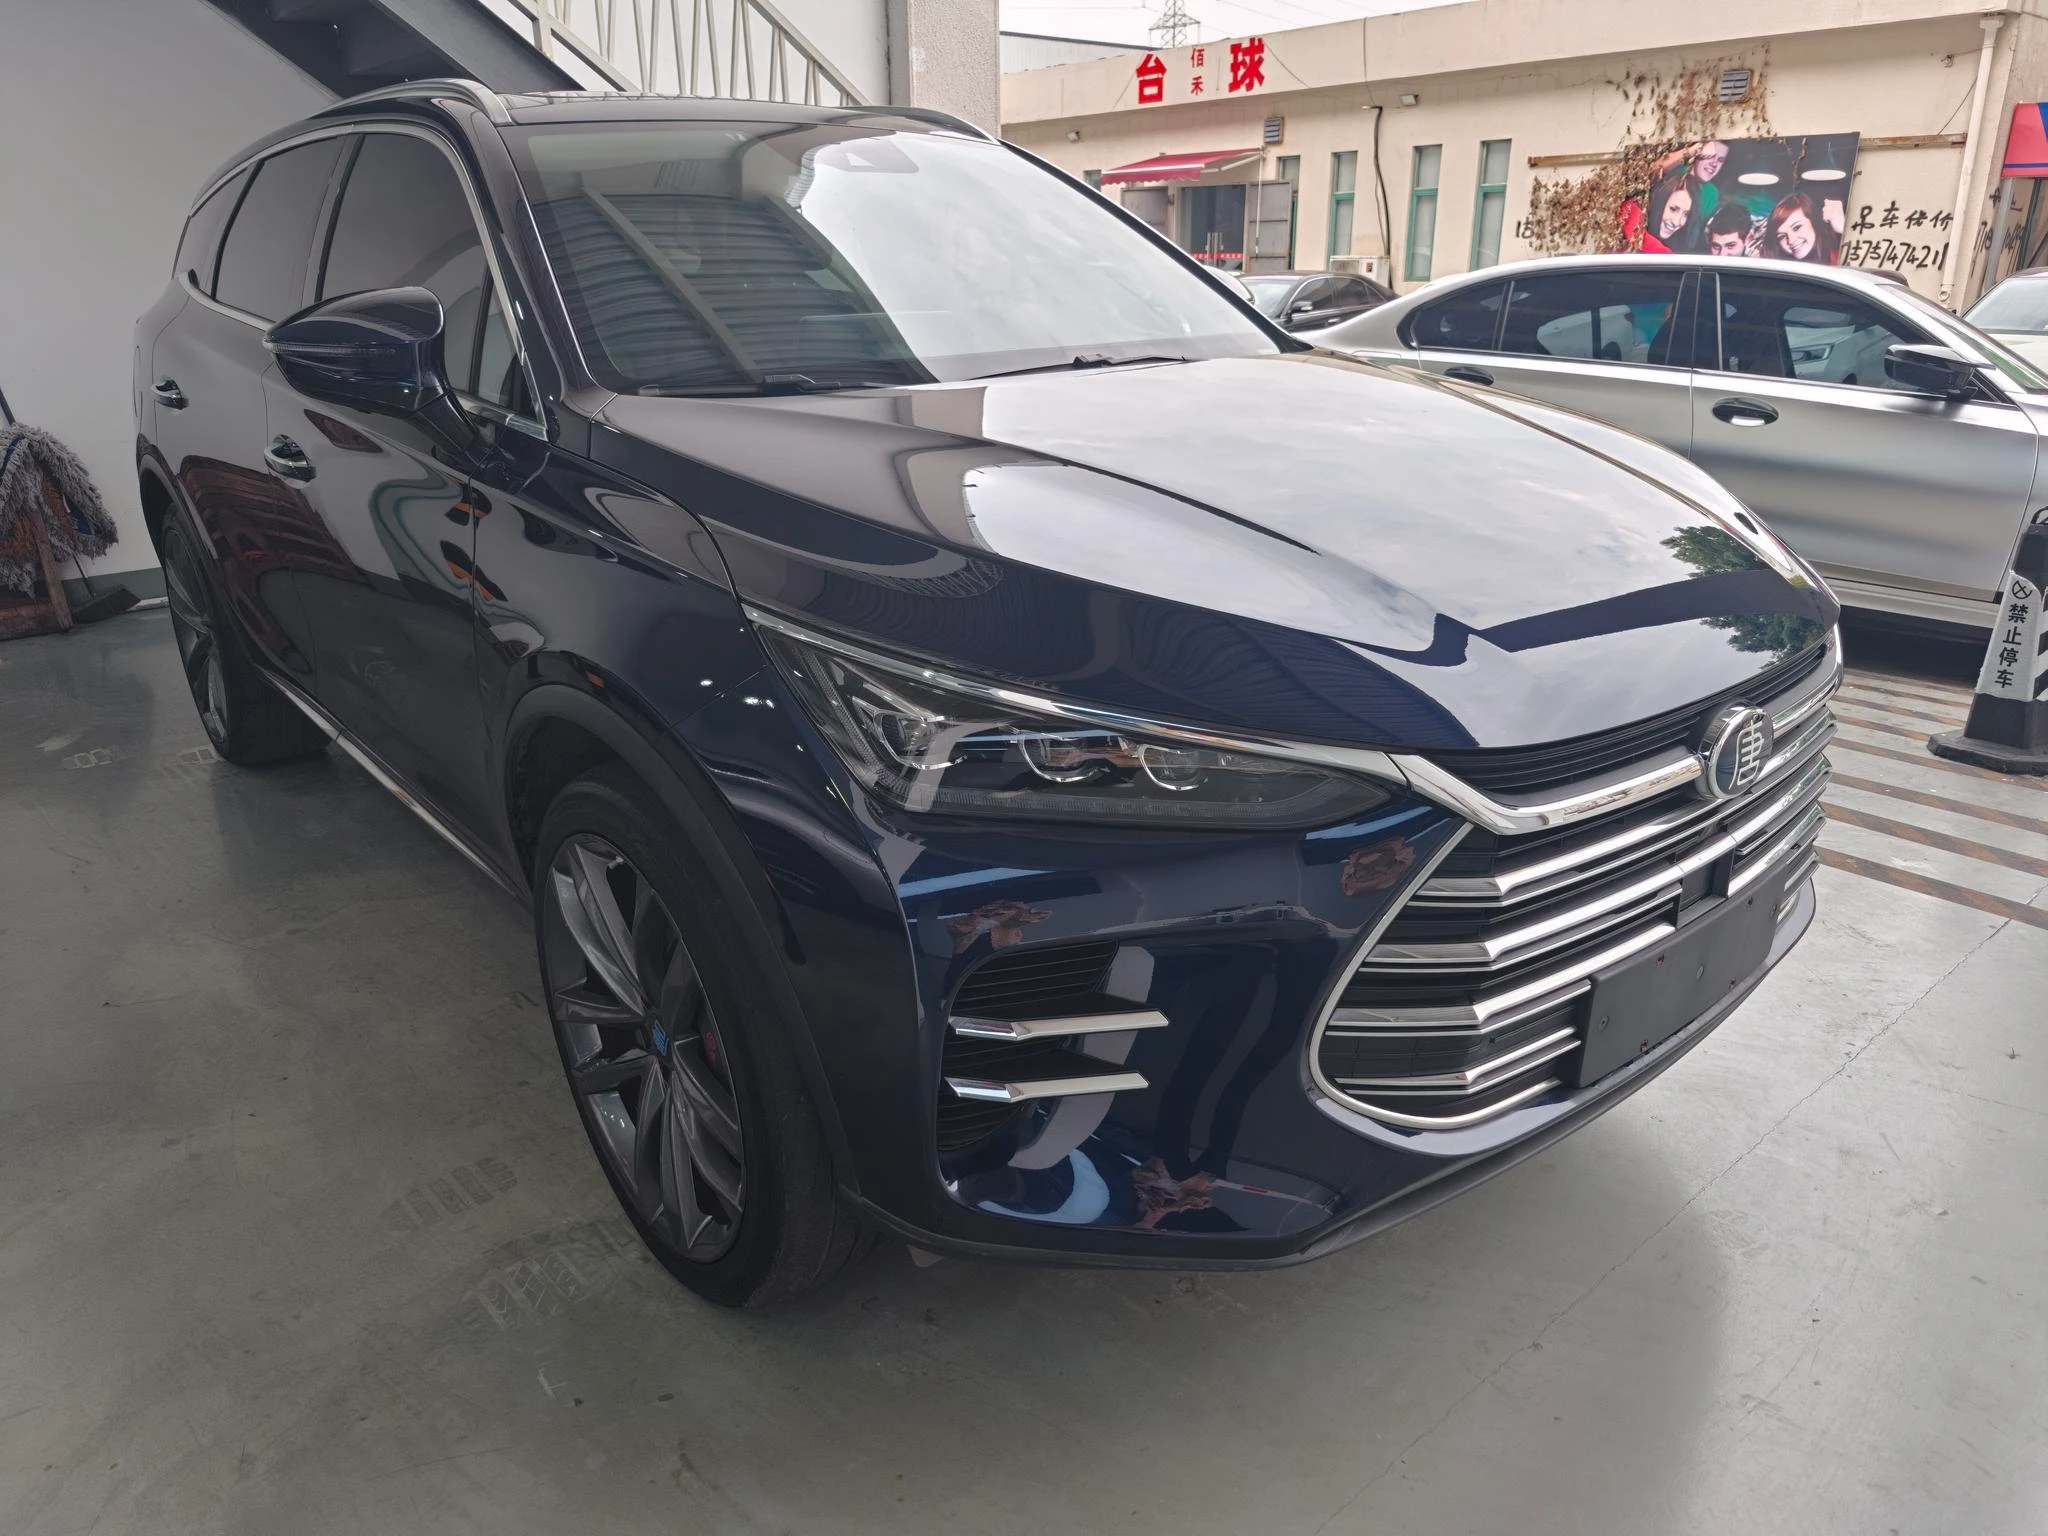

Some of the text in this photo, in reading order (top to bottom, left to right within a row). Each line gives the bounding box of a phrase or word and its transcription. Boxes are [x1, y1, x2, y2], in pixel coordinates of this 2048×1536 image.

[1136, 37, 1265, 104] 台 球
[1190, 47, 1205, 96] 佰禾
[1994, 603, 2029, 689] 禁止停车
